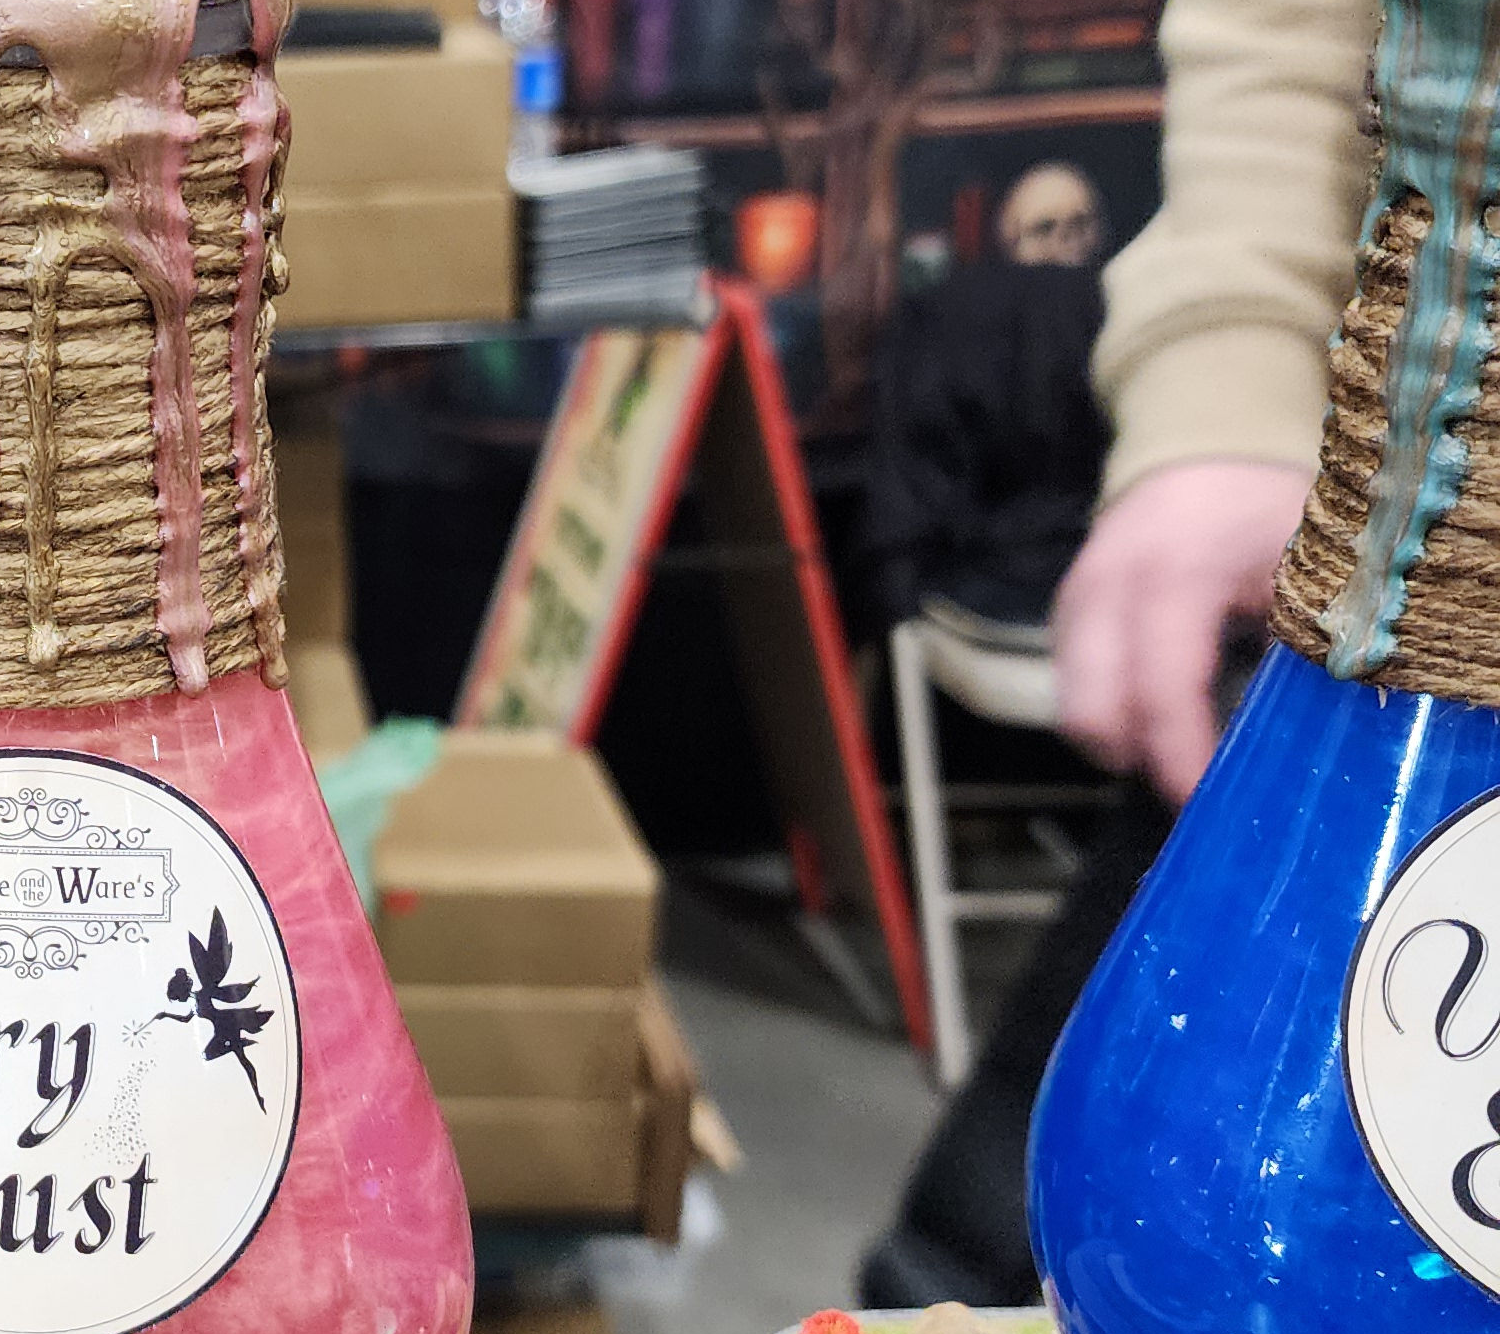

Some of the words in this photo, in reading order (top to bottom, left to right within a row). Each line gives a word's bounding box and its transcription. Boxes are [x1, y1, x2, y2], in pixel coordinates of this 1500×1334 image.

[19, 874, 46, 889] and
[51, 865, 156, 905] Ware's
[22, 887, 45, 902] the
